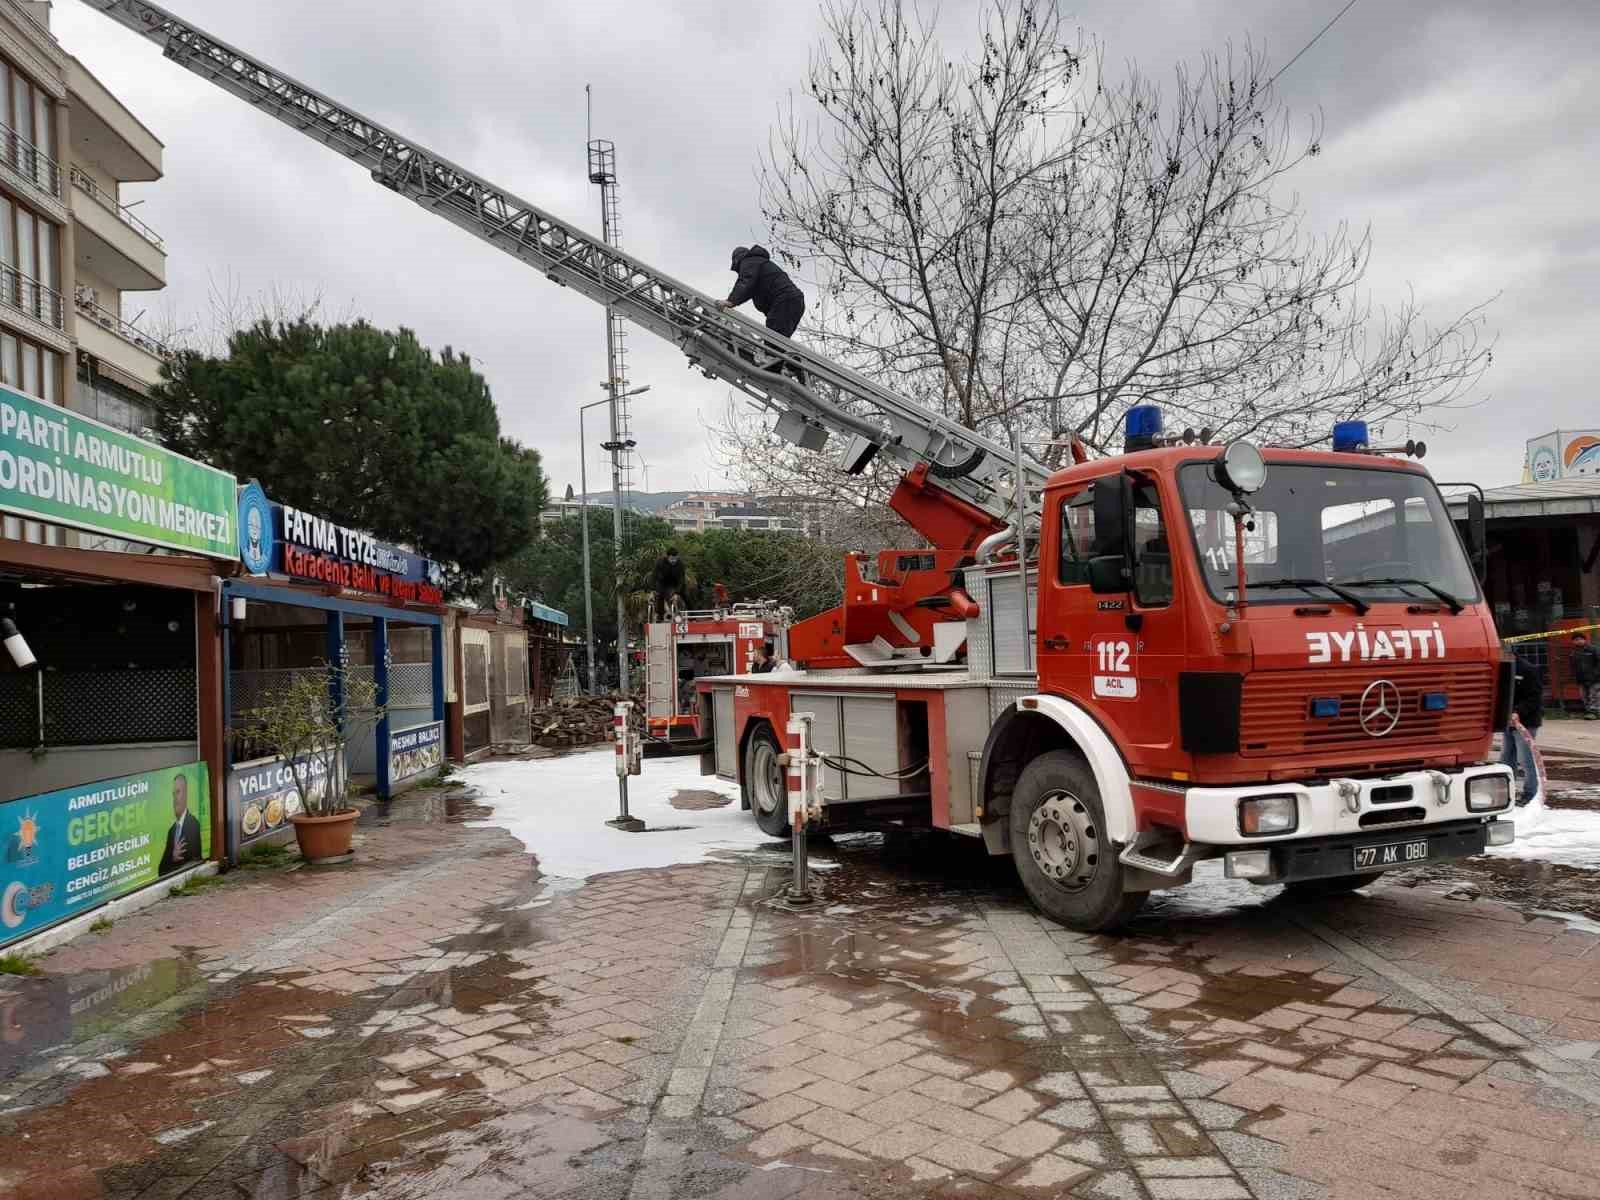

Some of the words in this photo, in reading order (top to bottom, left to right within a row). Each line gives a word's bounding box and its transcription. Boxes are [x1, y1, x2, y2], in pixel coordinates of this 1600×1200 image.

[1, 403, 70, 455] PARTİ
[74, 431, 163, 485] ARMUTLU
[0, 450, 154, 525] ORDİNASYON
[159, 499, 231, 545] MERKEZİ
[284, 505, 338, 556] FATMA
[340, 527, 378, 568] TEYZE
[1097, 601, 1123, 610] 1422
[1097, 641, 1130, 672] 112
[68, 785, 127, 812] ARMUTLU
[239, 772, 272, 796] YALI
[68, 800, 148, 846] GERÇEK
[66, 867, 109, 893] CENGİZ
[110, 853, 151, 878] ARSLAN
[1361, 848, 1377, 866] 77
[1383, 846, 1398, 863] AK
